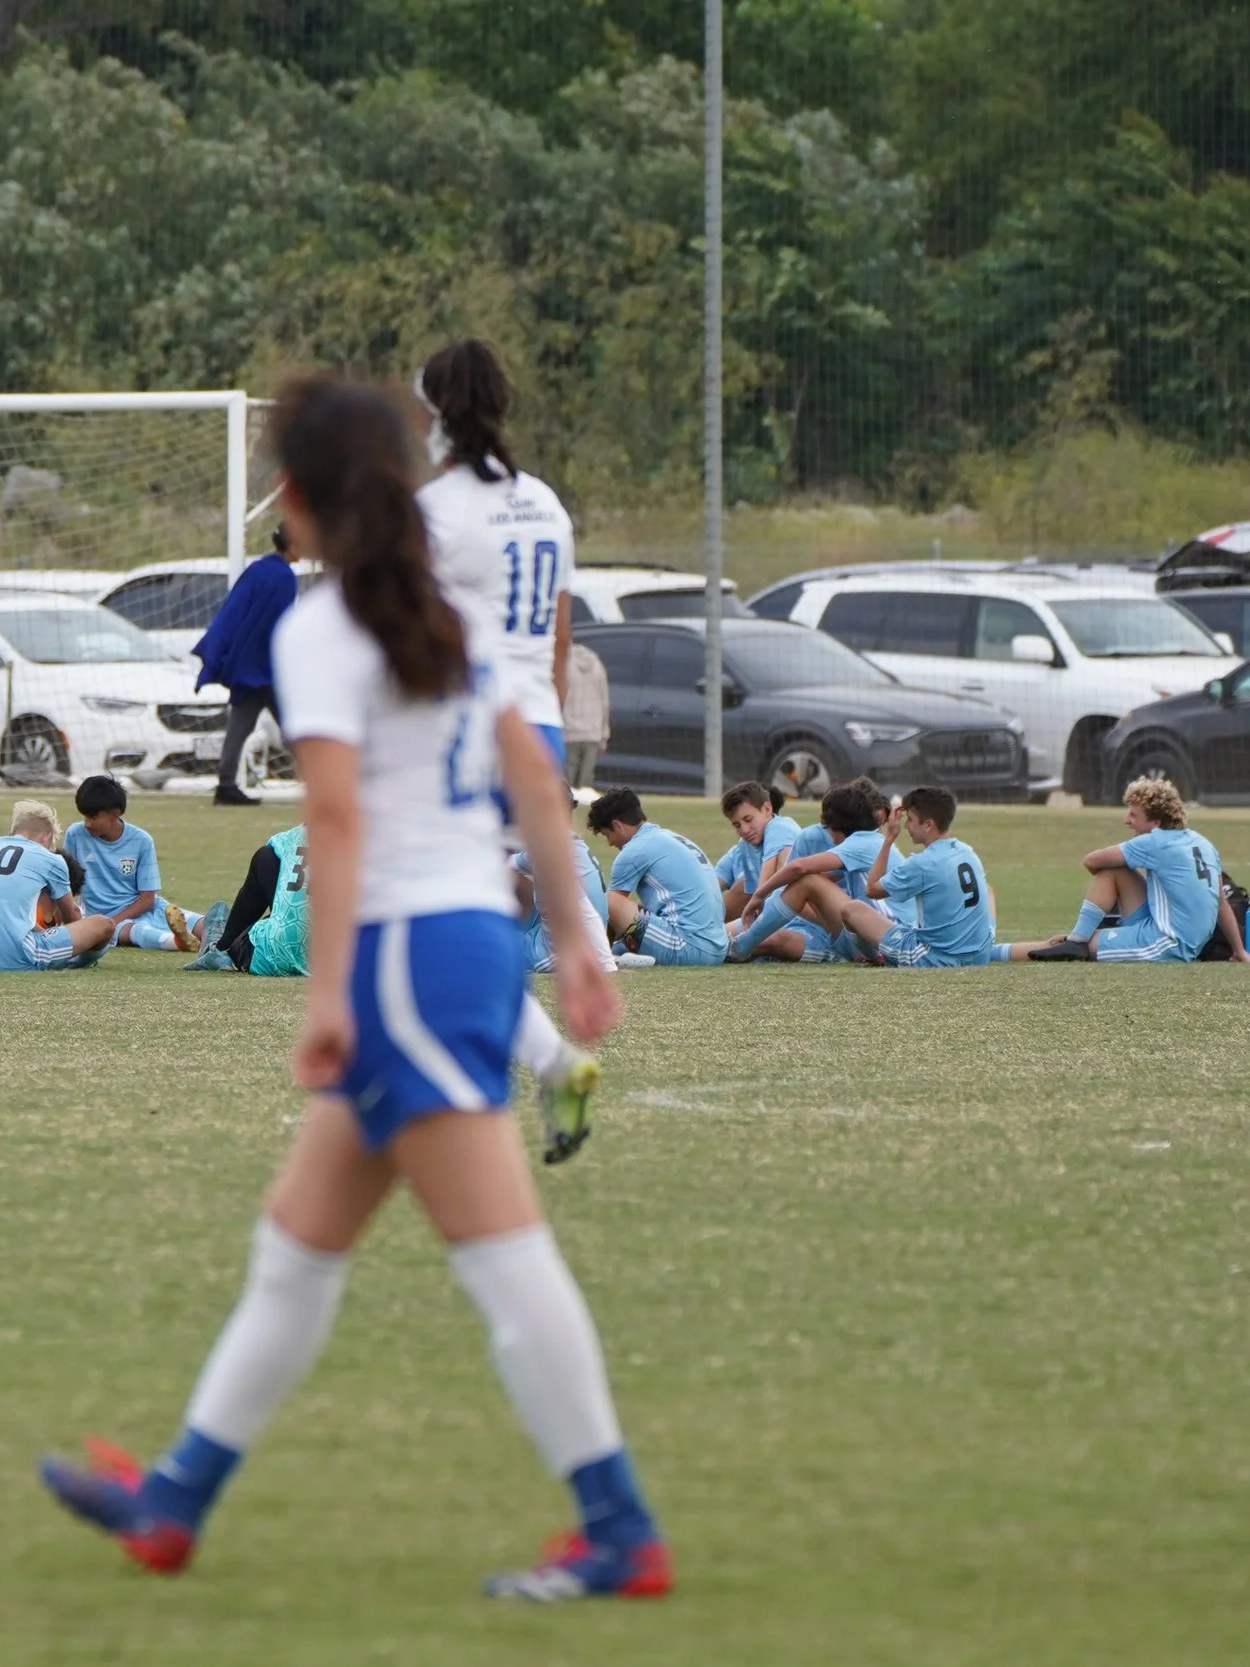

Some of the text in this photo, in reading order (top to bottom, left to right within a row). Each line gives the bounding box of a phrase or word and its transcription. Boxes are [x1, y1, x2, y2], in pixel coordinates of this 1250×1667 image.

[504, 541, 557, 634] 10
[957, 862, 980, 909] 9
[1192, 846, 1212, 888] 4
